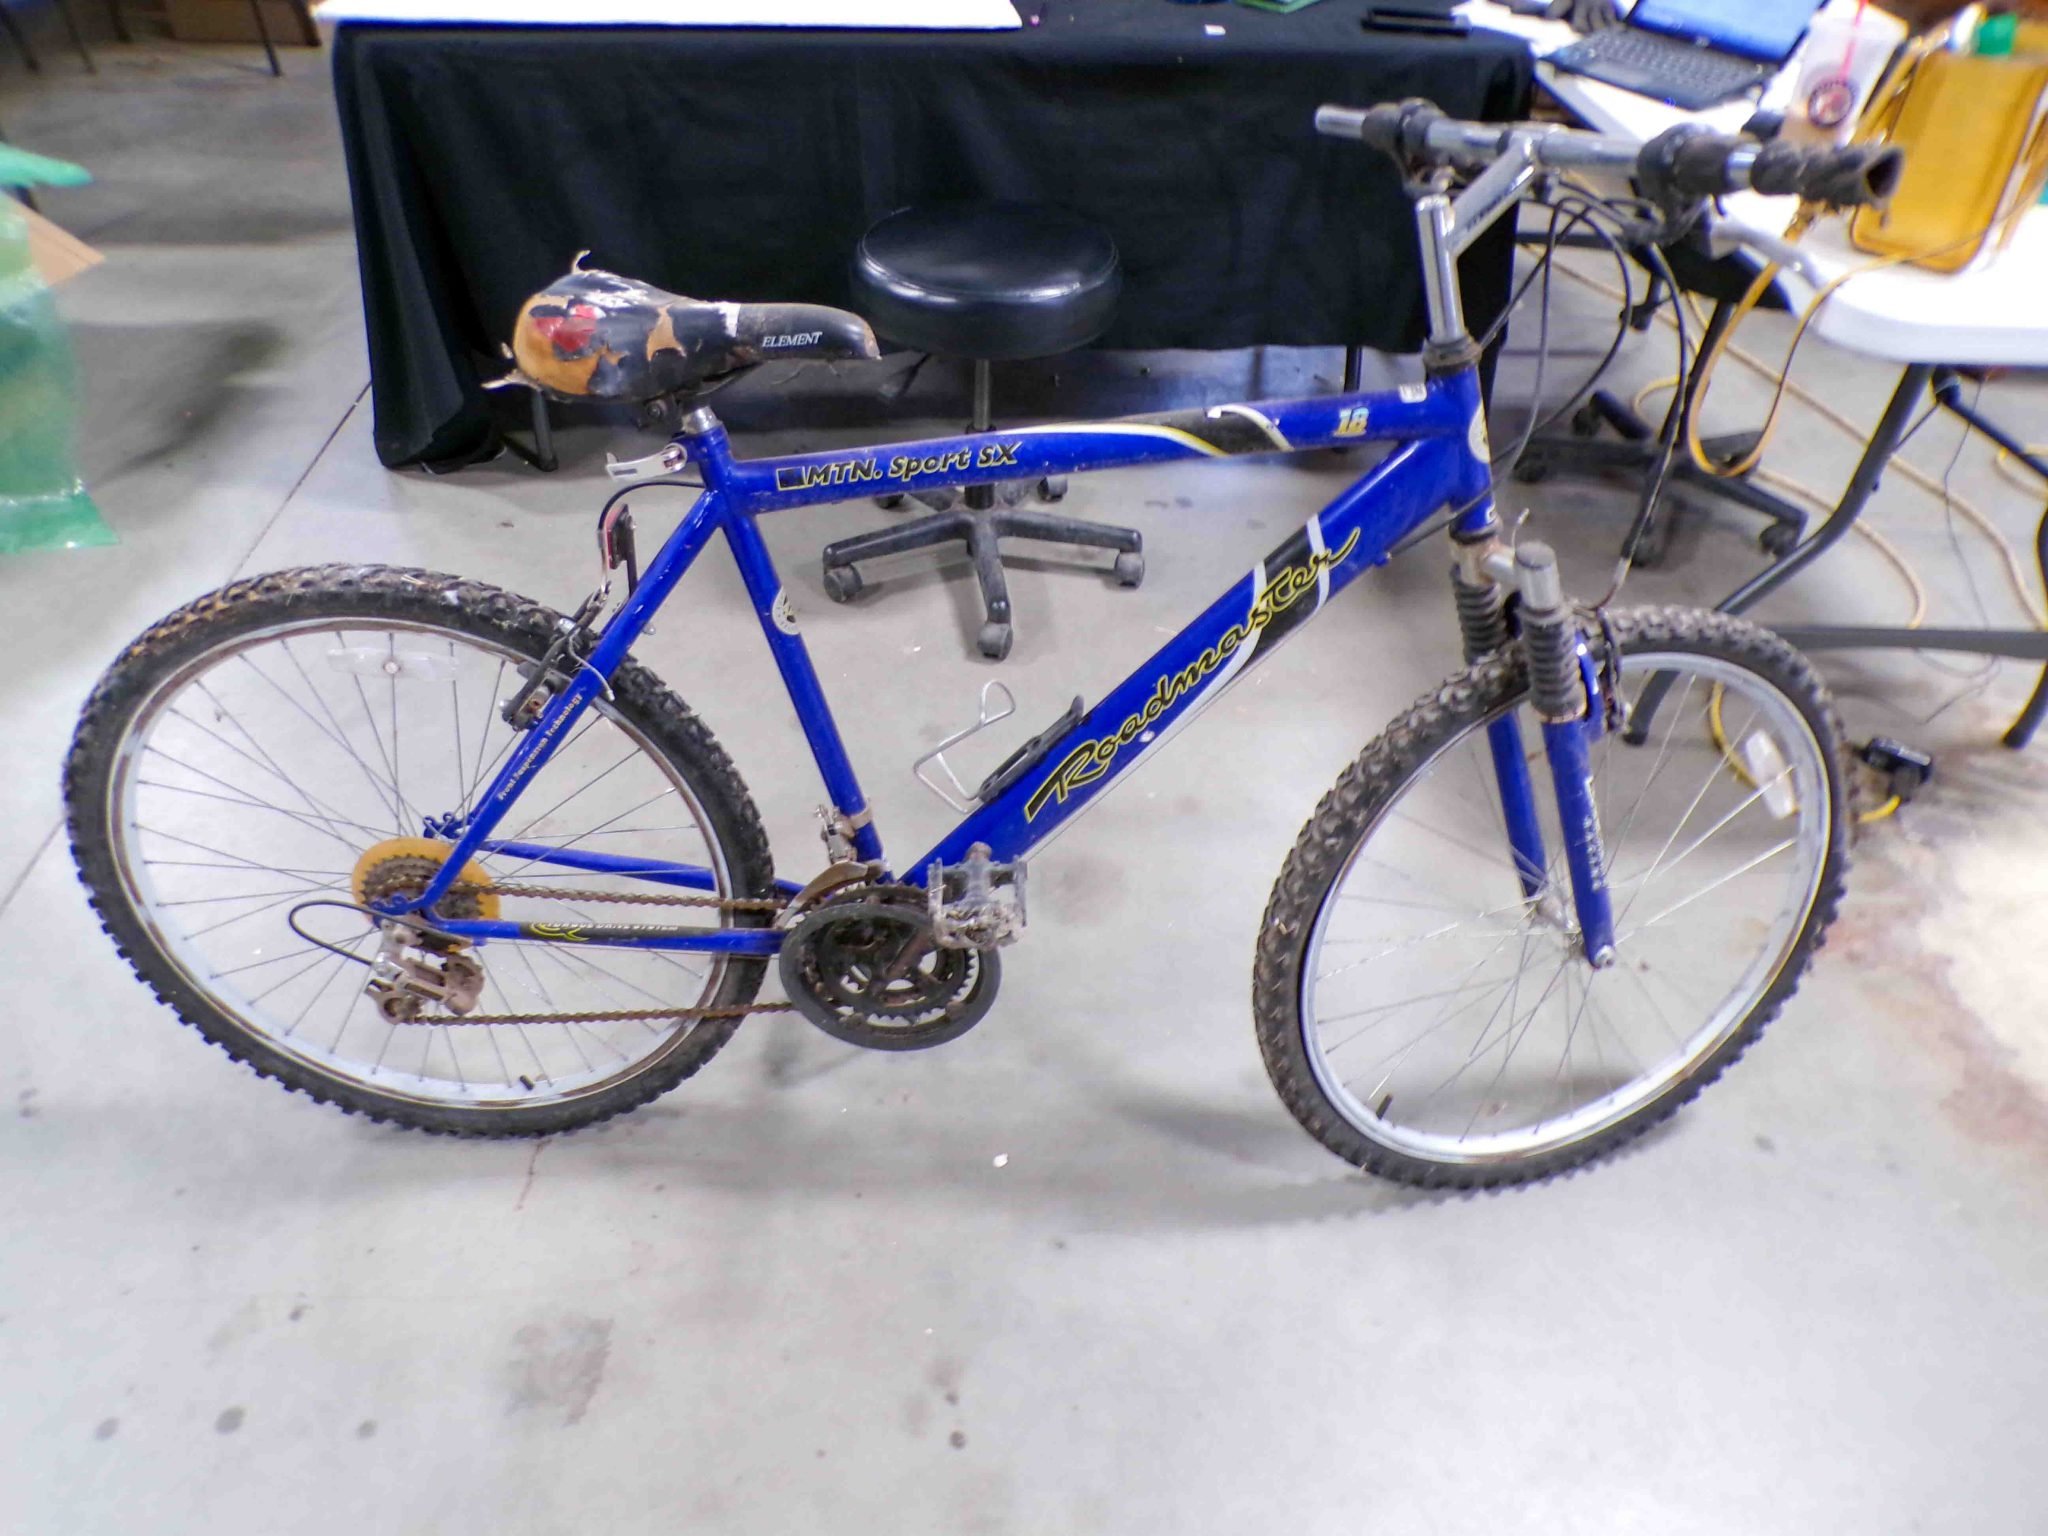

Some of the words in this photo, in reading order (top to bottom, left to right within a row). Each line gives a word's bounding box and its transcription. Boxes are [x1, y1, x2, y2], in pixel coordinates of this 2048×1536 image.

[762, 331, 823, 348] ELEMENT
[1333, 406, 1369, 437] 18
[806, 458, 883, 487] MTN.
[888, 448, 972, 481] Sport
[976, 441, 1023, 468] SX
[1024, 527, 1361, 823] Roadmaster
[546, 693, 583, 737] Technology
